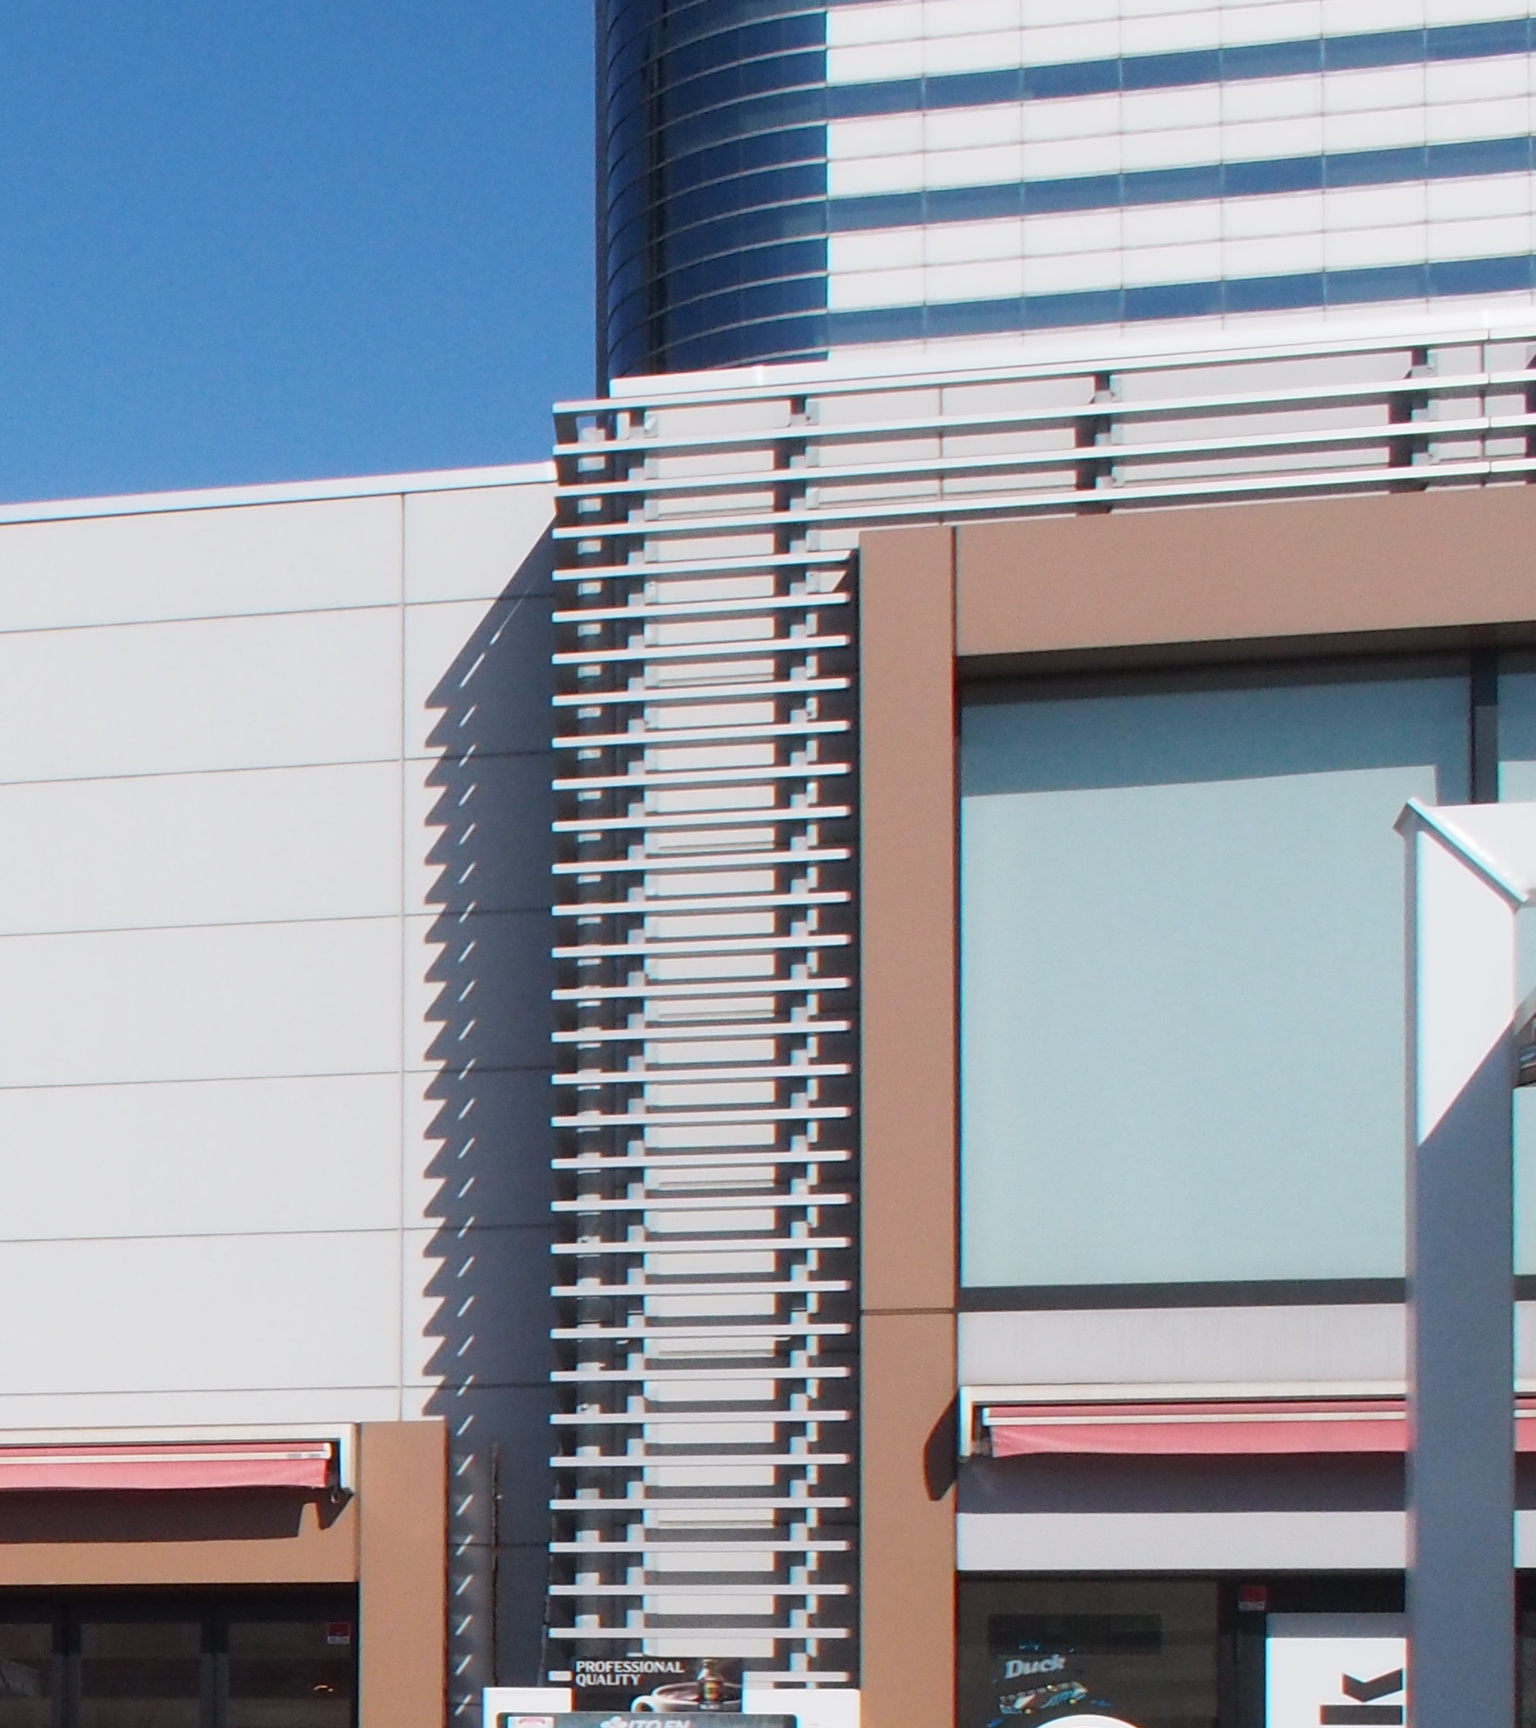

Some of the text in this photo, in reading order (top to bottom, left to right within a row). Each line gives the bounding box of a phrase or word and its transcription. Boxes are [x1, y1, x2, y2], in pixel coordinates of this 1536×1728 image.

[575, 1661, 685, 1673] PROFESSIONAL
[1004, 1654, 1066, 1679] Duck
[575, 1673, 641, 1686] QUALITY
